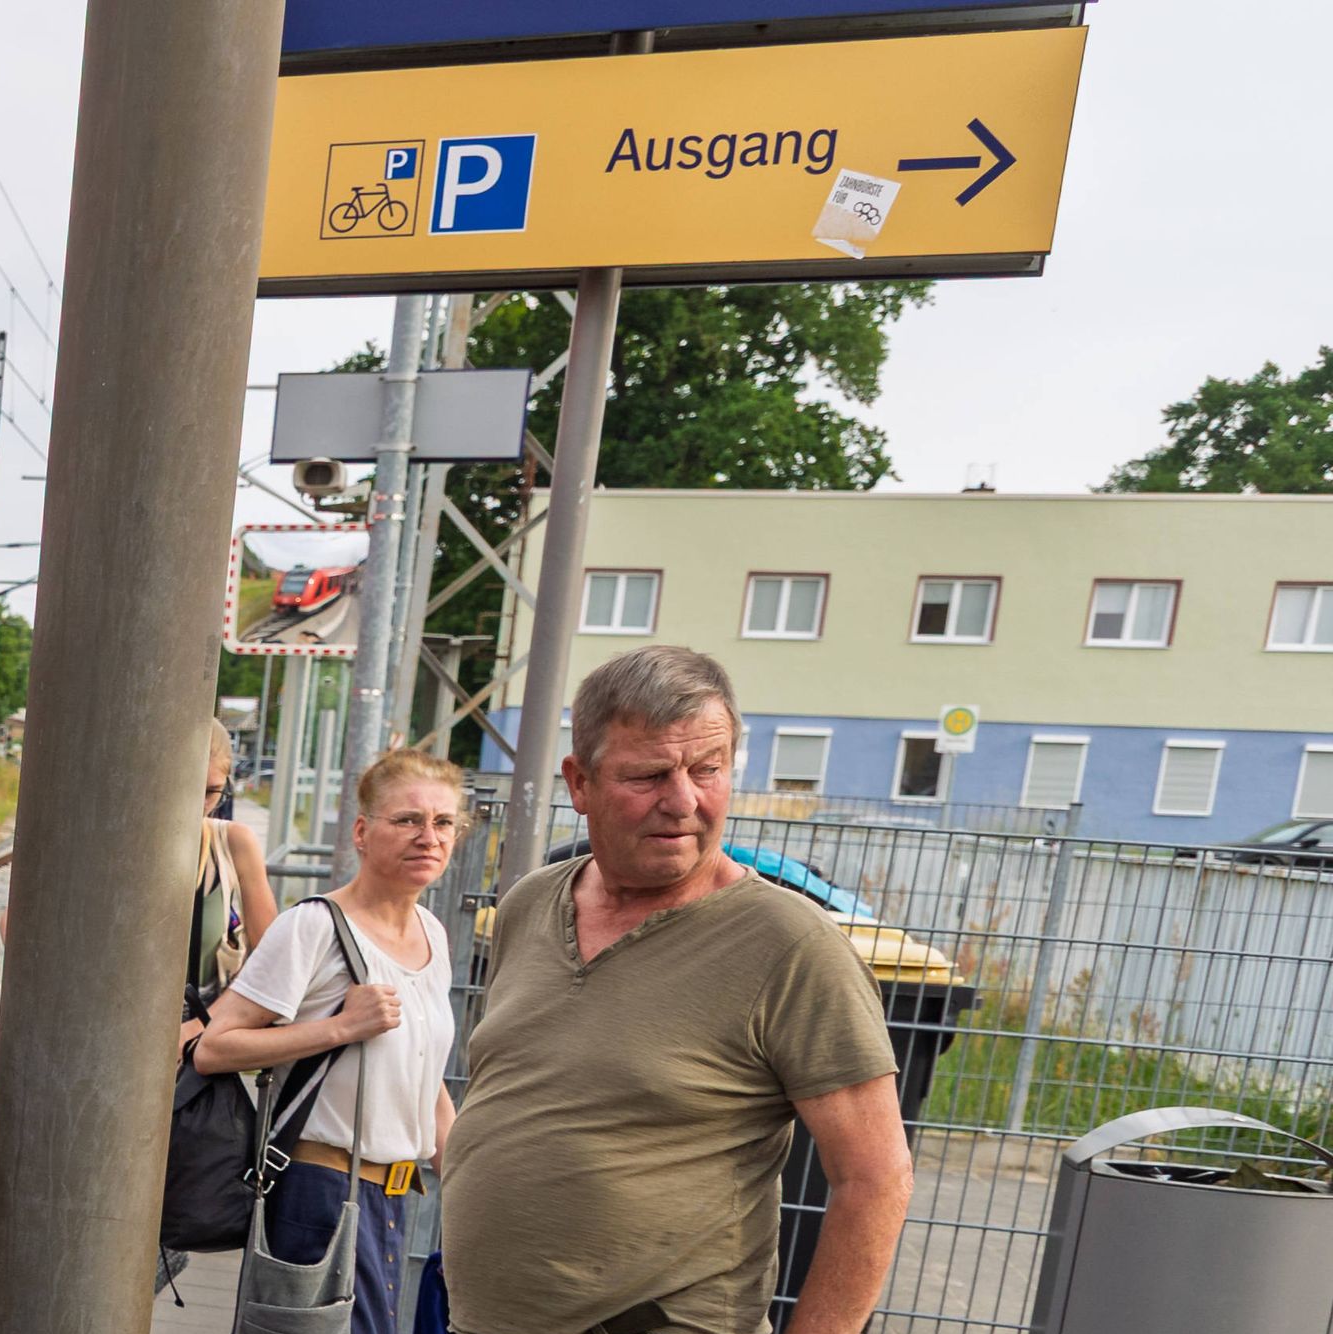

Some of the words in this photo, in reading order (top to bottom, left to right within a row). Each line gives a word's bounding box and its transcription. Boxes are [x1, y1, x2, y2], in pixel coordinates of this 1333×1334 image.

[386, 150, 409, 180] P
[605, 128, 838, 180] Ausgang
[439, 144, 502, 229] P
